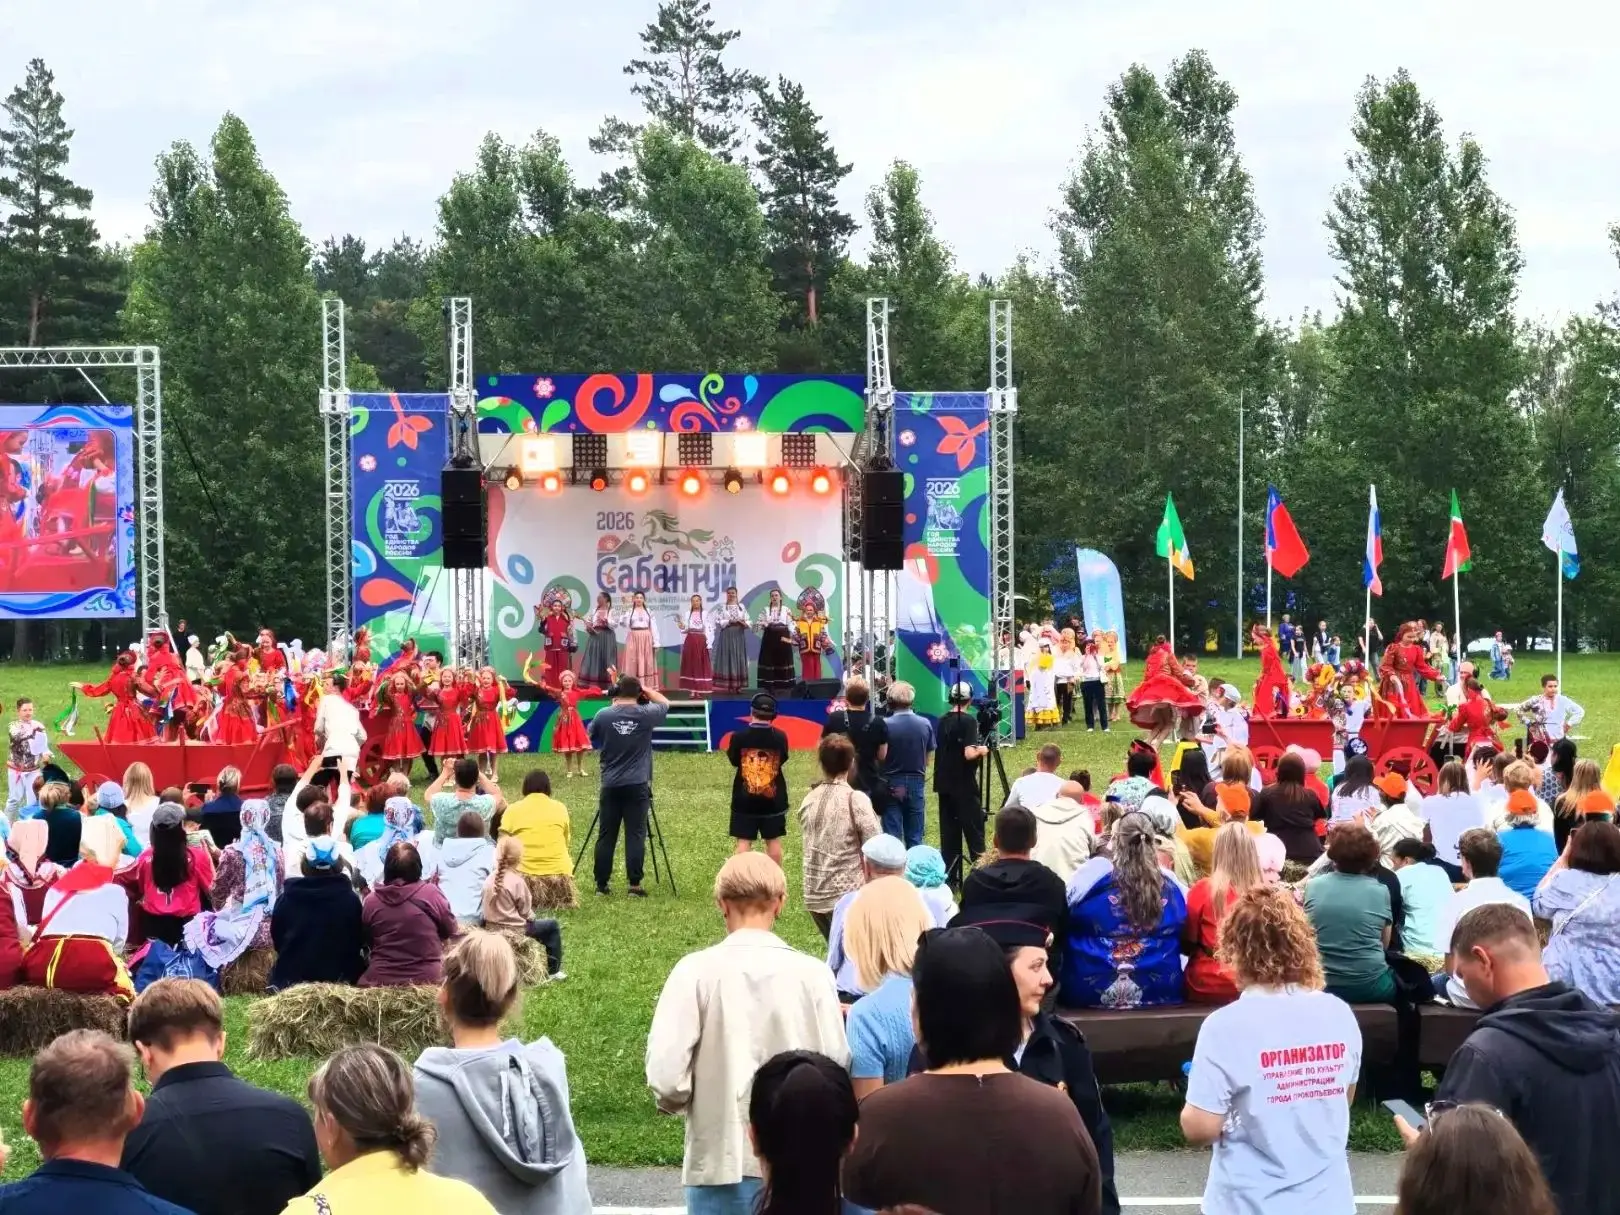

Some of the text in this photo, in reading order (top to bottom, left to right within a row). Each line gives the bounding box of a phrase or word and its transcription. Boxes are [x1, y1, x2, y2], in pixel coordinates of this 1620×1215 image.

[384, 483, 420, 497] 2026
[926, 481, 960, 495] 2026
[596, 511, 635, 531] 2026
[596, 554, 737, 602] Сабантуй
[1260, 1043, 1345, 1068] ОРГАНИЗАТОР
[1305, 1066, 1316, 1076] ПО
[1277, 1076, 1336, 1091] АДМИНИСТРАЦИИ
[1267, 1087, 1345, 1104] ГОРОДА ПРОКОПЬЕВСКА
